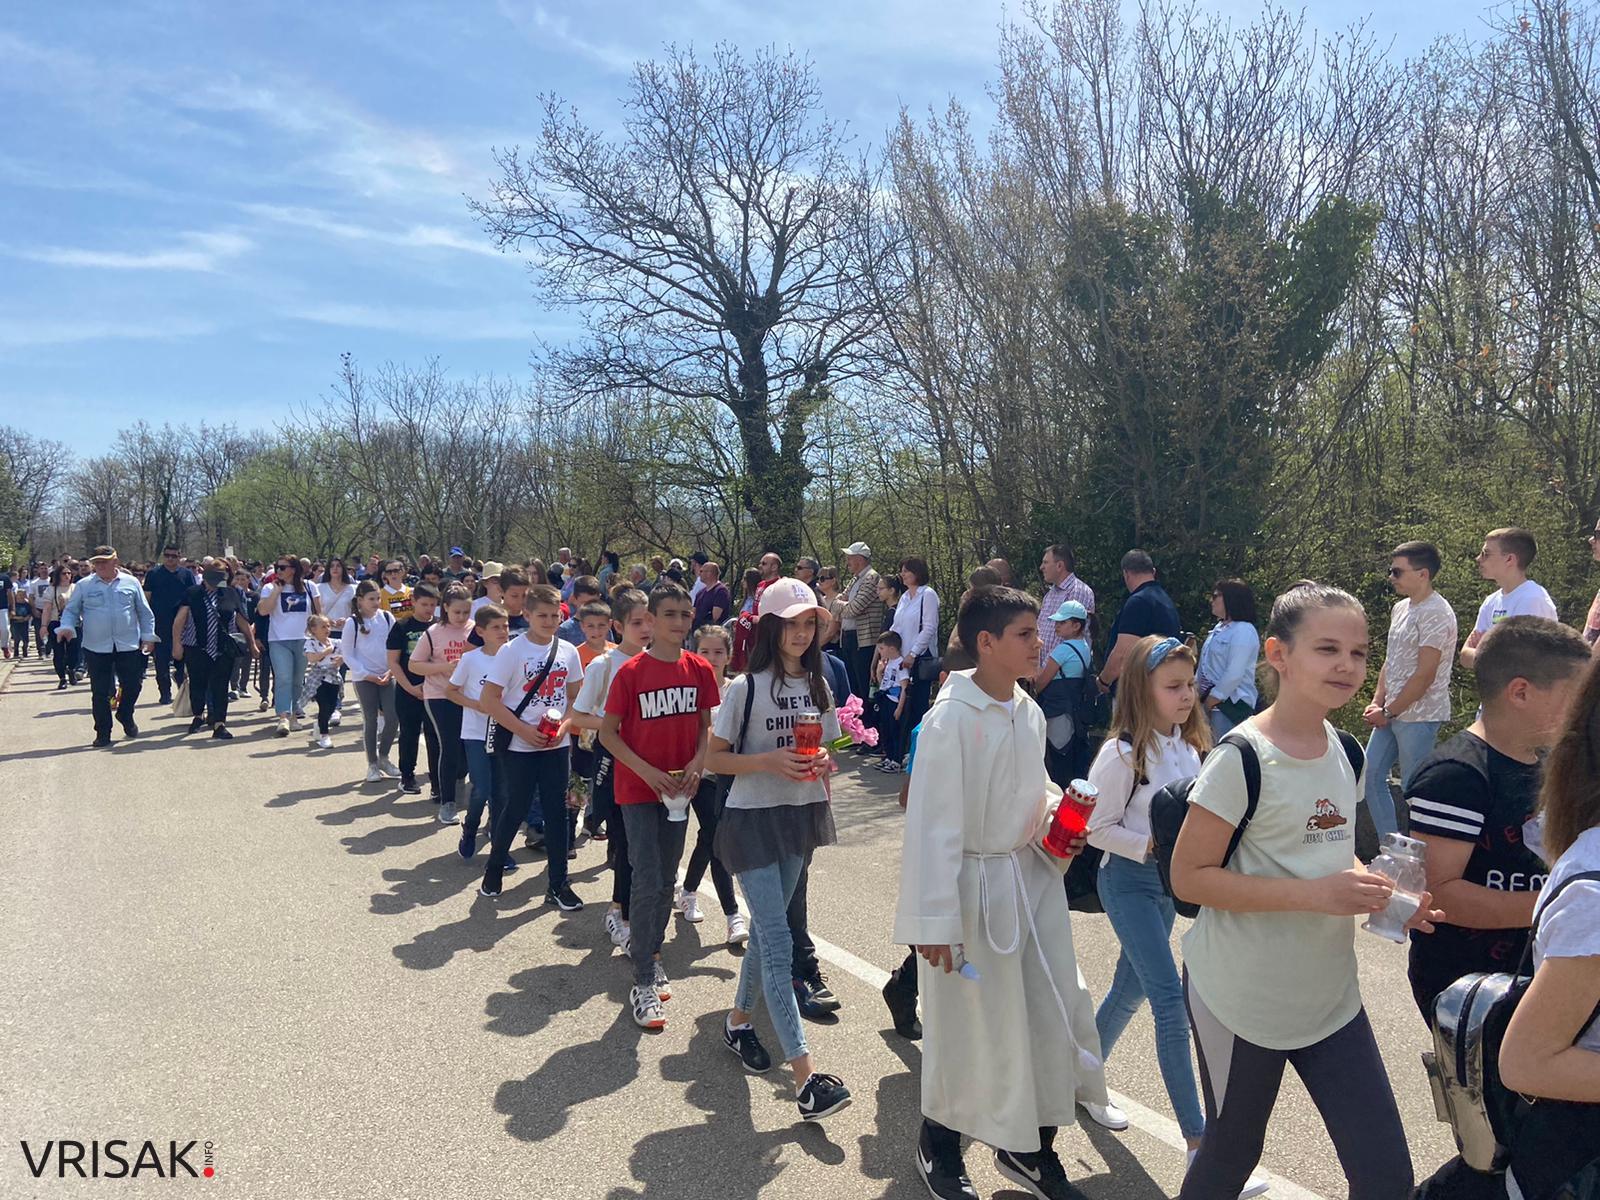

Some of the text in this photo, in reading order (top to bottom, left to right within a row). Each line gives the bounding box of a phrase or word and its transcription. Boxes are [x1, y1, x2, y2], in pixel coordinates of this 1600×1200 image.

[639, 687, 698, 719] MARVEL
[776, 735, 794, 748] OF
[1302, 832, 1324, 844] JUST
